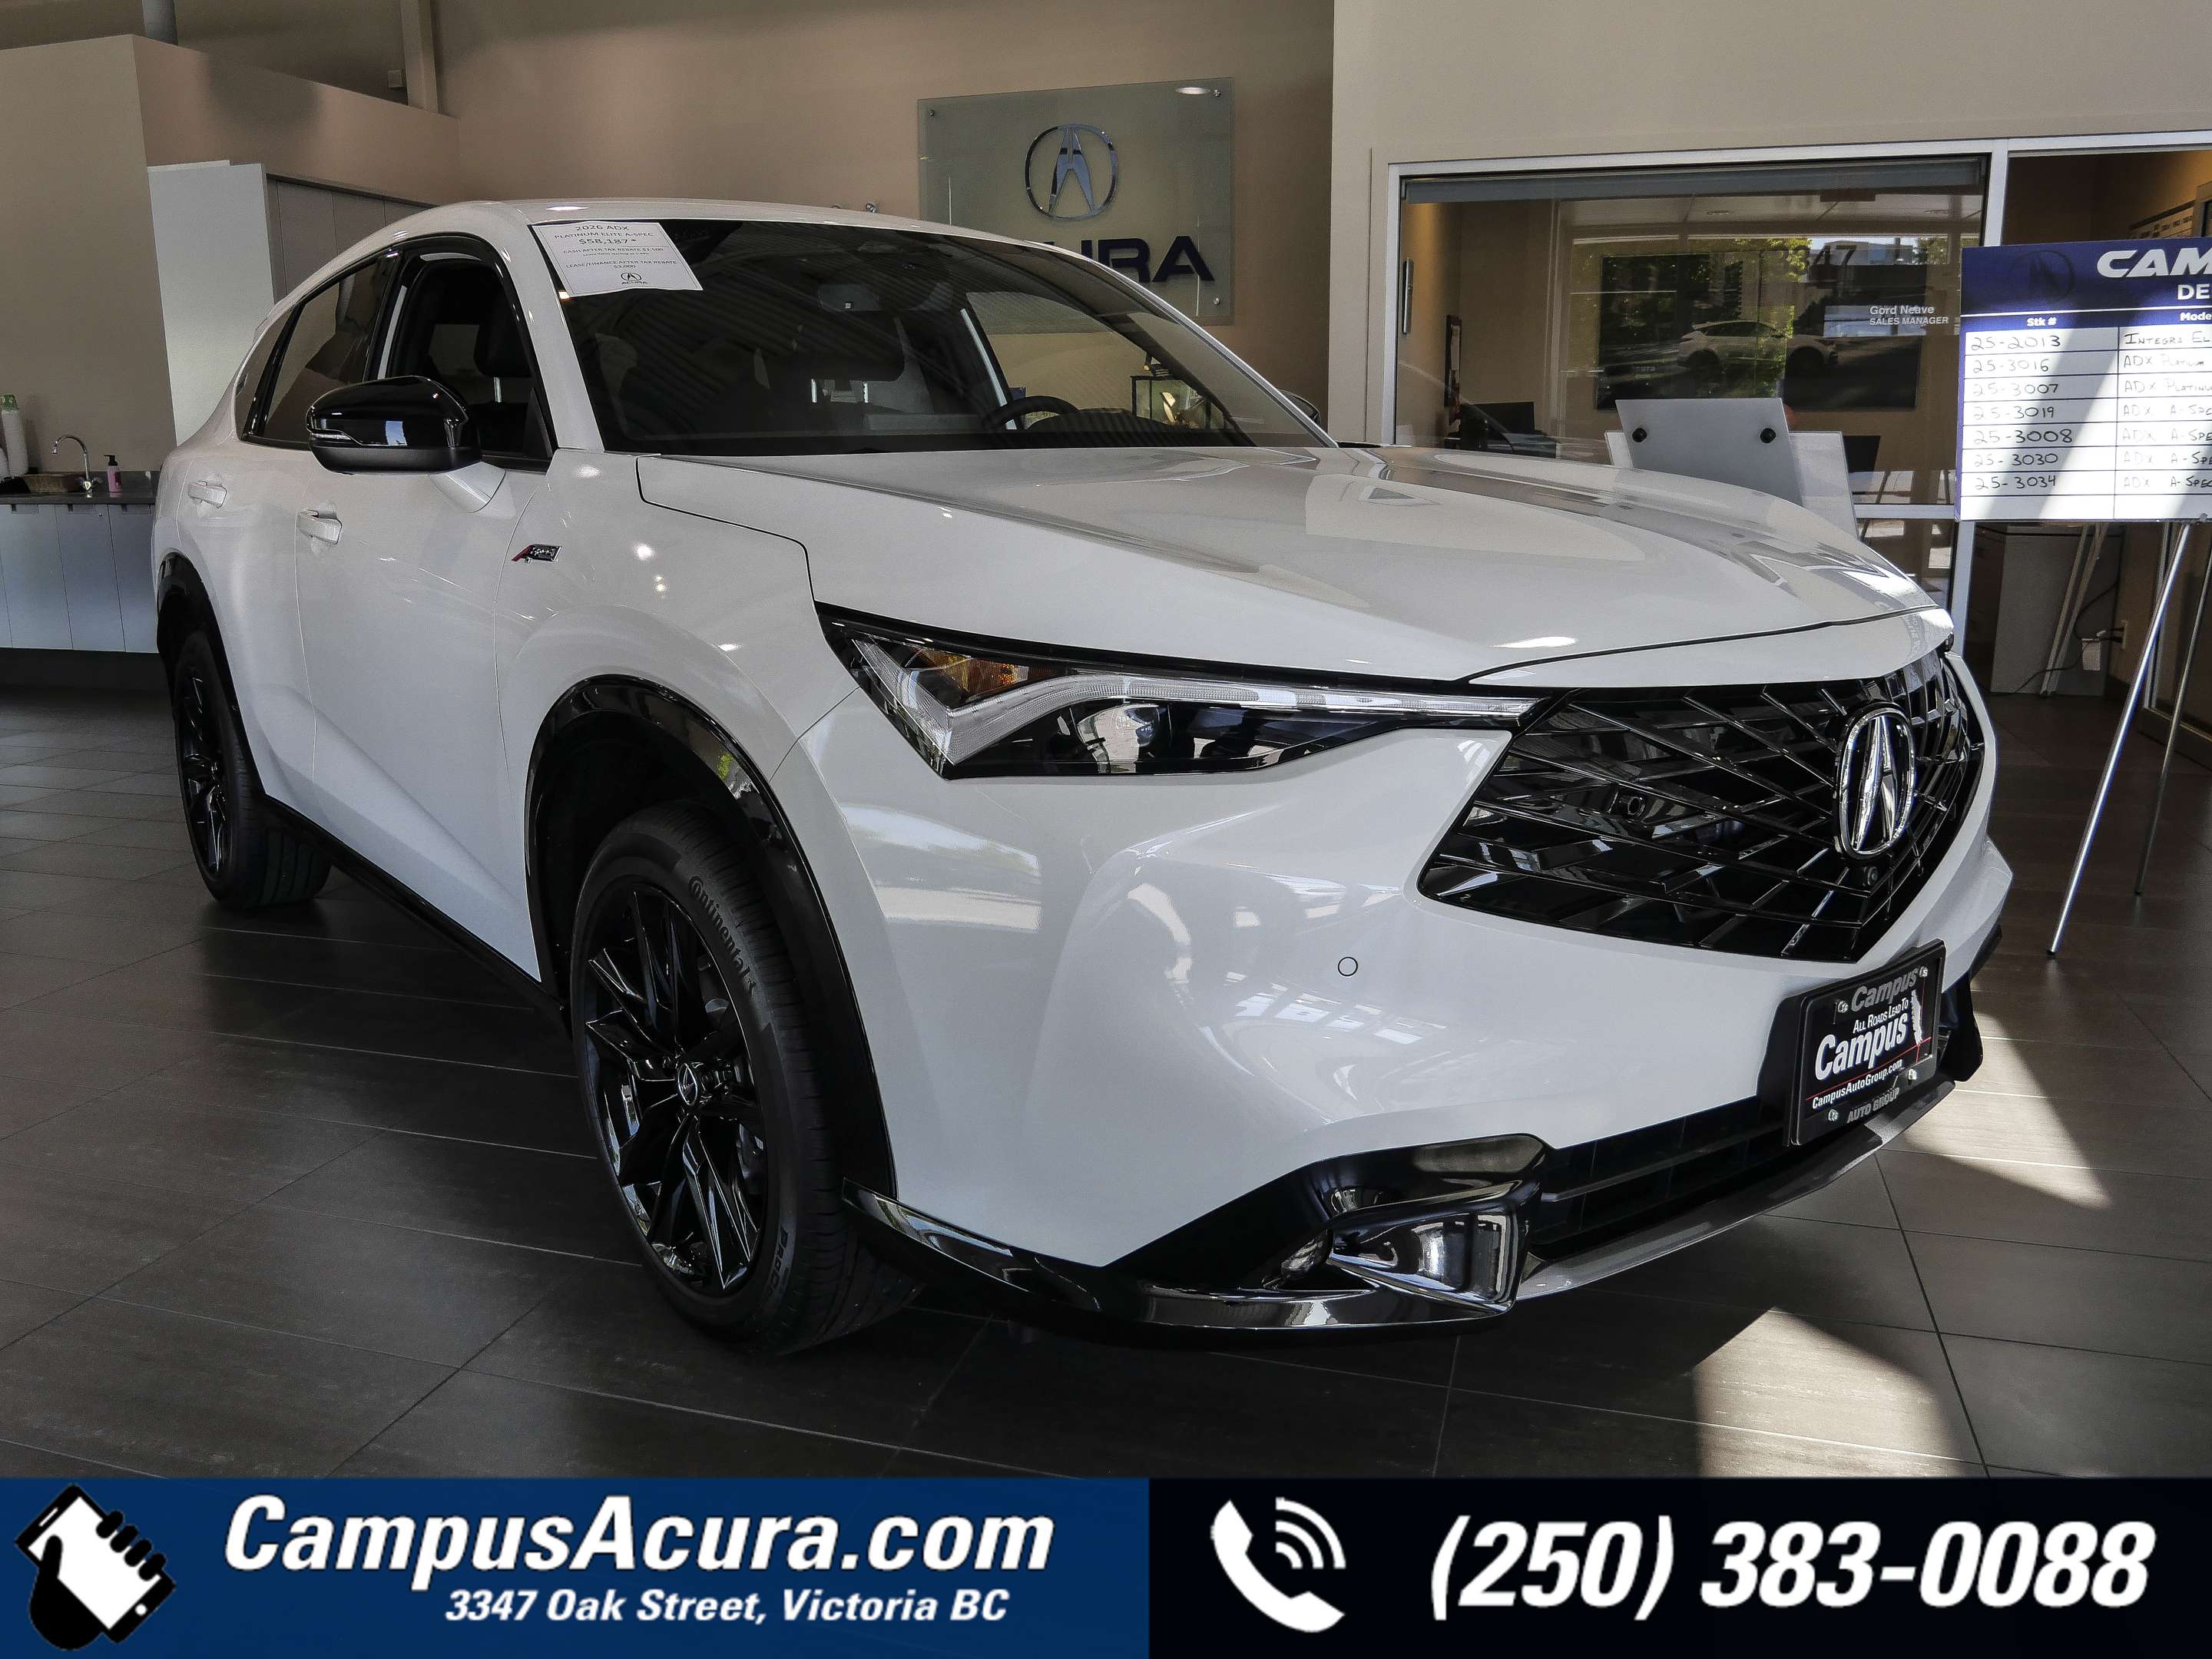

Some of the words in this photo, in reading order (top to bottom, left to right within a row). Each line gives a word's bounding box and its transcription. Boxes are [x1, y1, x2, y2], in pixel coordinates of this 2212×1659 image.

[2177, 283, 2210, 300] DE
[1869, 306, 1897, 315] Gord
[1899, 305, 1935, 314] Neave
[2180, 312, 2212, 321] Mode
[1869, 317, 1899, 326] SALES
[1902, 316, 1949, 325] MANAGER
[2026, 316, 2047, 326] Stk
[2048, 316, 2057, 326] #
[1971, 335, 2061, 350] 25-2013
[1973, 359, 2050, 373] 25-3016
[2124, 355, 2152, 369] ADX
[1973, 382, 2058, 396] 25-3007
[2124, 380, 2156, 392] ADX
[1973, 406, 2055, 420] 25-3019
[1973, 429, 2072, 445] 25-3008
[1975, 453, 2058, 467] 25-3030
[1975, 475, 2056, 489] 25-3034
[1851, 968, 1918, 1012] Campus
[1853, 1019, 1866, 1034] ALL
[1867, 1011, 1888, 1028] ROADS
[1815, 1012, 1909, 1081] Campus
[1812, 1058, 1903, 1109] CampusAutoGroup.com
[1846, 1104, 1872, 1124] AUTO
